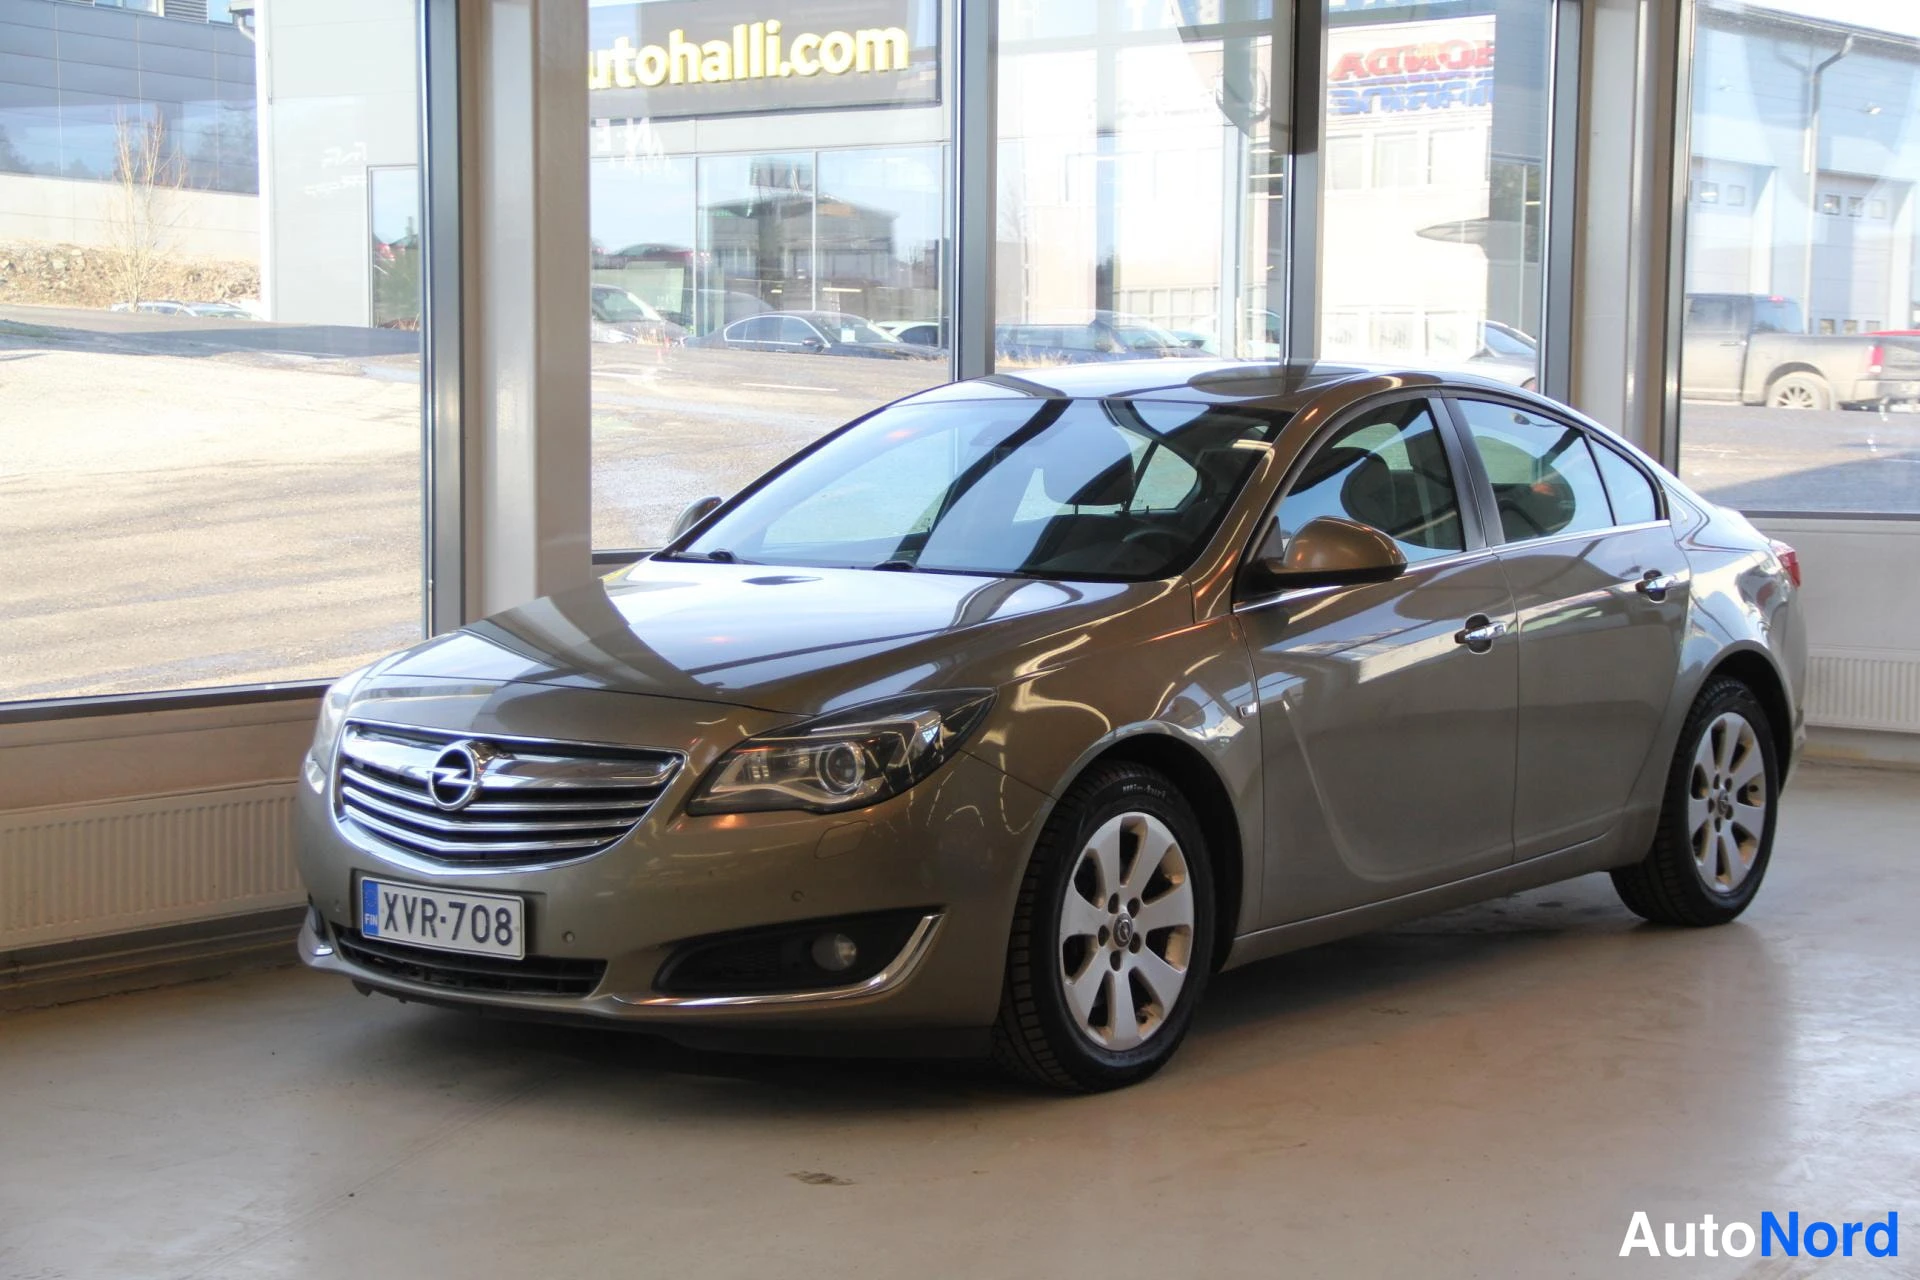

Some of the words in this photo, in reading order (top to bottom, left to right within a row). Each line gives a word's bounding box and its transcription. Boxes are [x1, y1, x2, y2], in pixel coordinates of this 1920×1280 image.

[584, 19, 909, 90] utohalli.com
[364, 913, 379, 926] FIN
[383, 892, 513, 947] XVR-708
